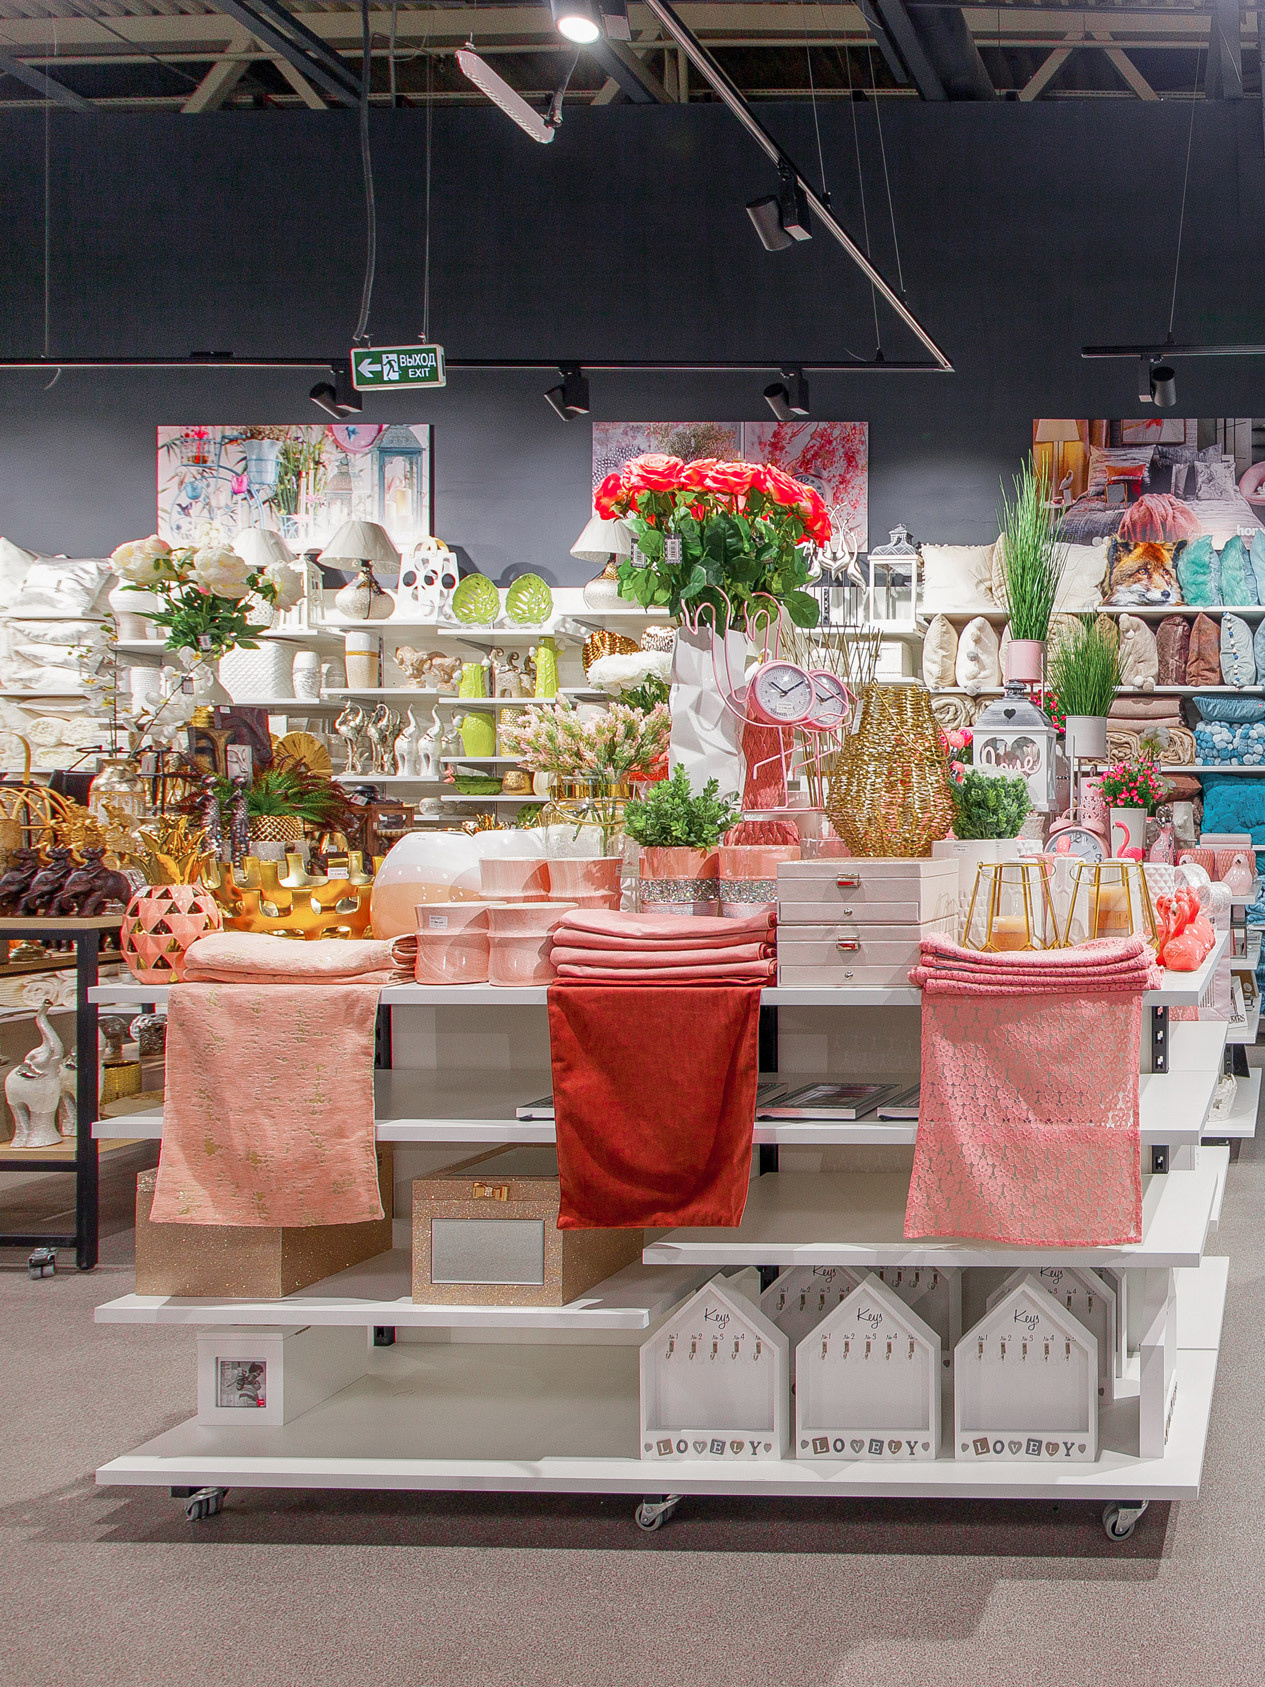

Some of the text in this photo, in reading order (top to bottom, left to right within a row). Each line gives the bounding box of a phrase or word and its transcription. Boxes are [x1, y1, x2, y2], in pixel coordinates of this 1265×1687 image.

[399, 353, 436, 367] ВЫХОД
[408, 368, 430, 378] EXIT
[813, 1265, 837, 1284] Keys
[1040, 1266, 1064, 1284] Keys
[704, 1308, 731, 1330] Keys
[857, 1308, 884, 1329] Keys
[1014, 1309, 1040, 1330] Keys
[657, 1439, 761, 1456] LOVELY
[812, 1437, 918, 1455] LOVELY
[973, 1437, 1075, 1456] LOVELY
